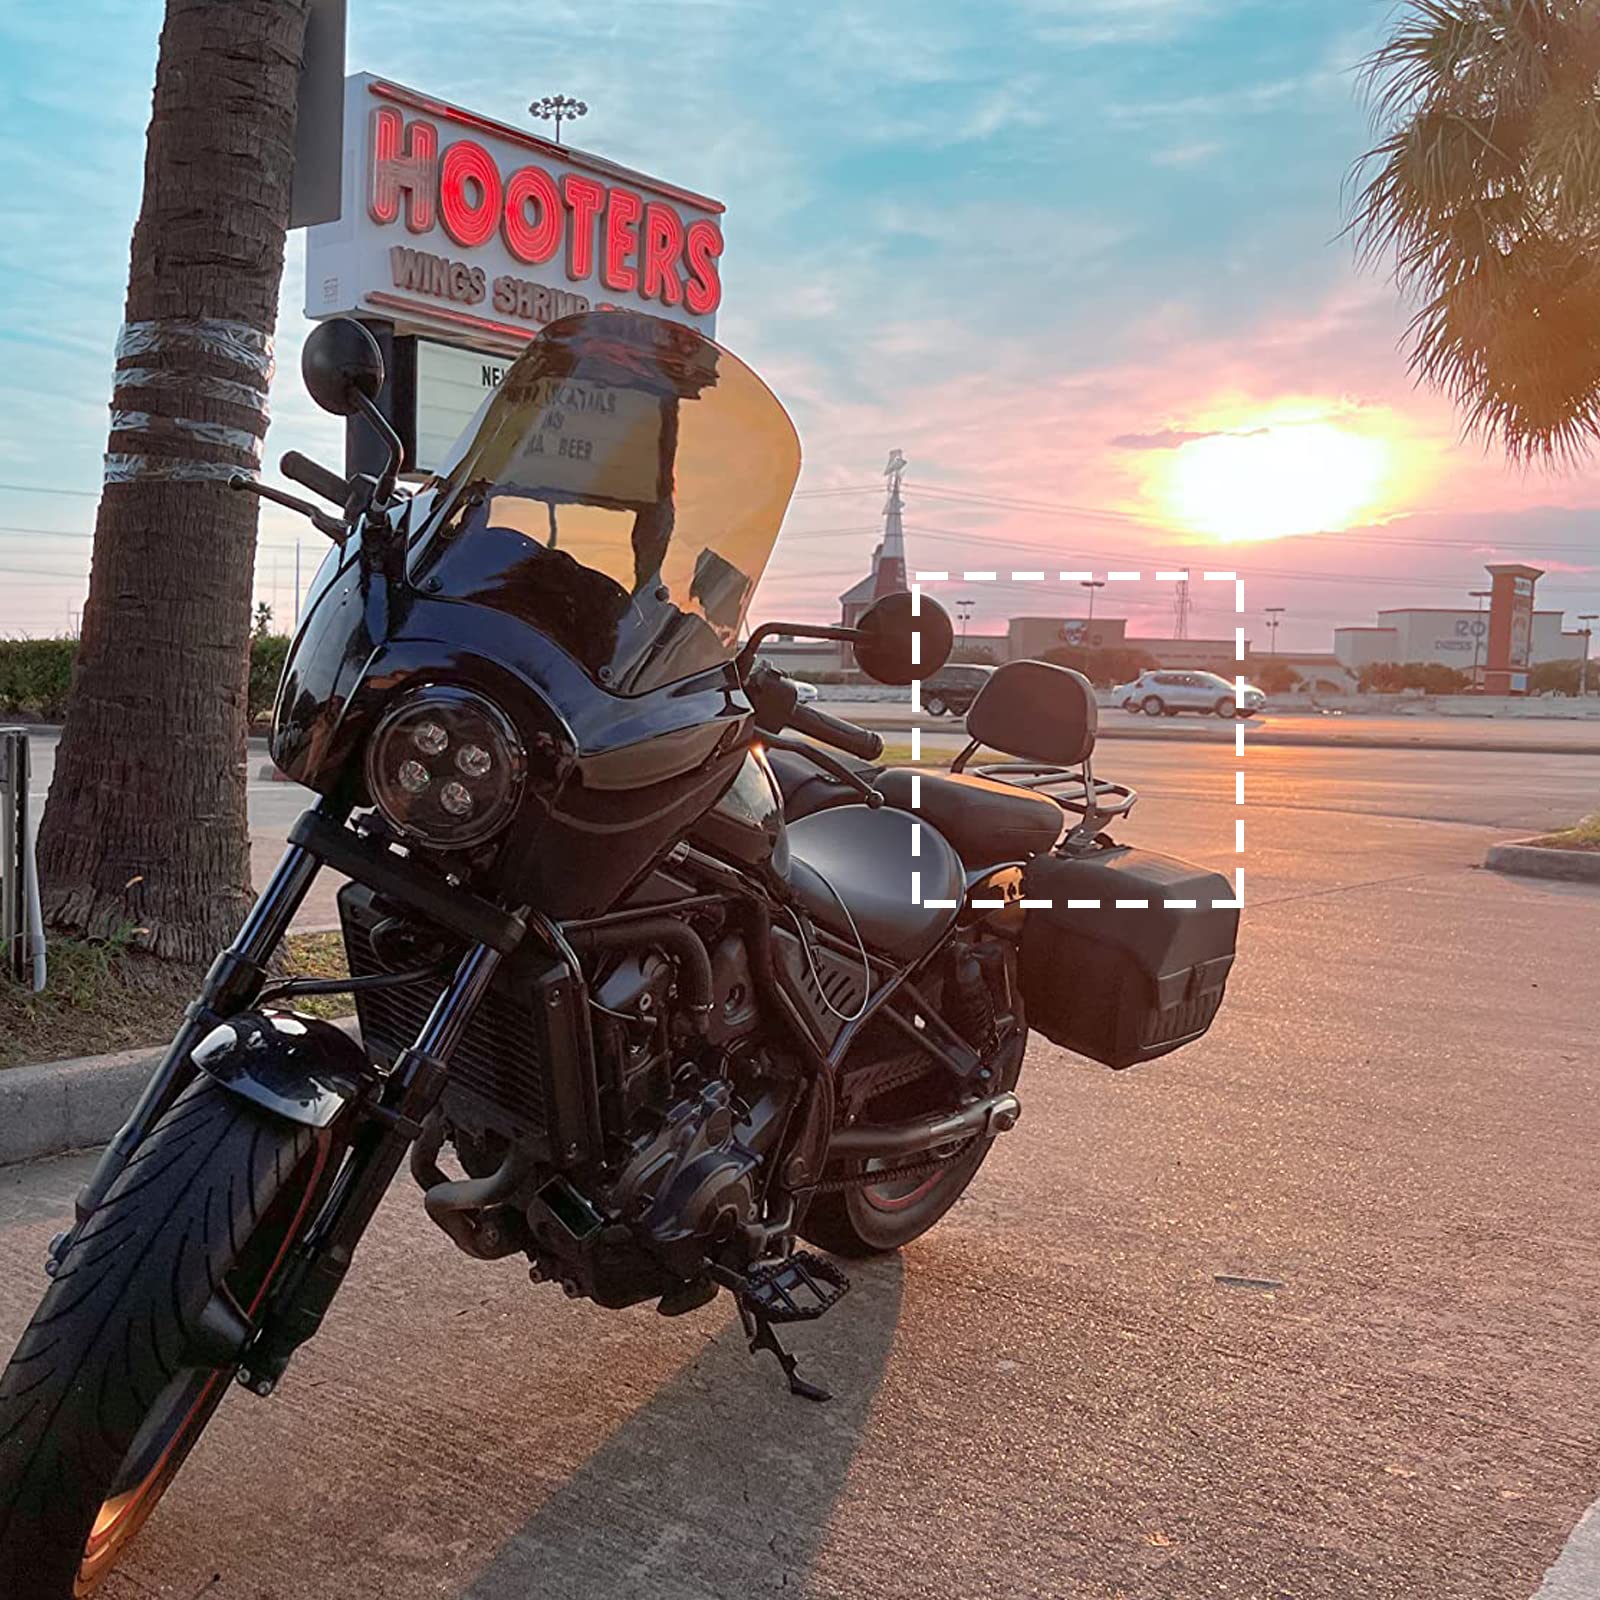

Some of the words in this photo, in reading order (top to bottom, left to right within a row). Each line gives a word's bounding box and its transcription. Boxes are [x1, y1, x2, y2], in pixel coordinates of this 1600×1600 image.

[368, 107, 724, 315] HOOTERS
[390, 246, 486, 305] WINGS
[492, 274, 590, 324] SHRIMP
[558, 437, 593, 463] BEER
